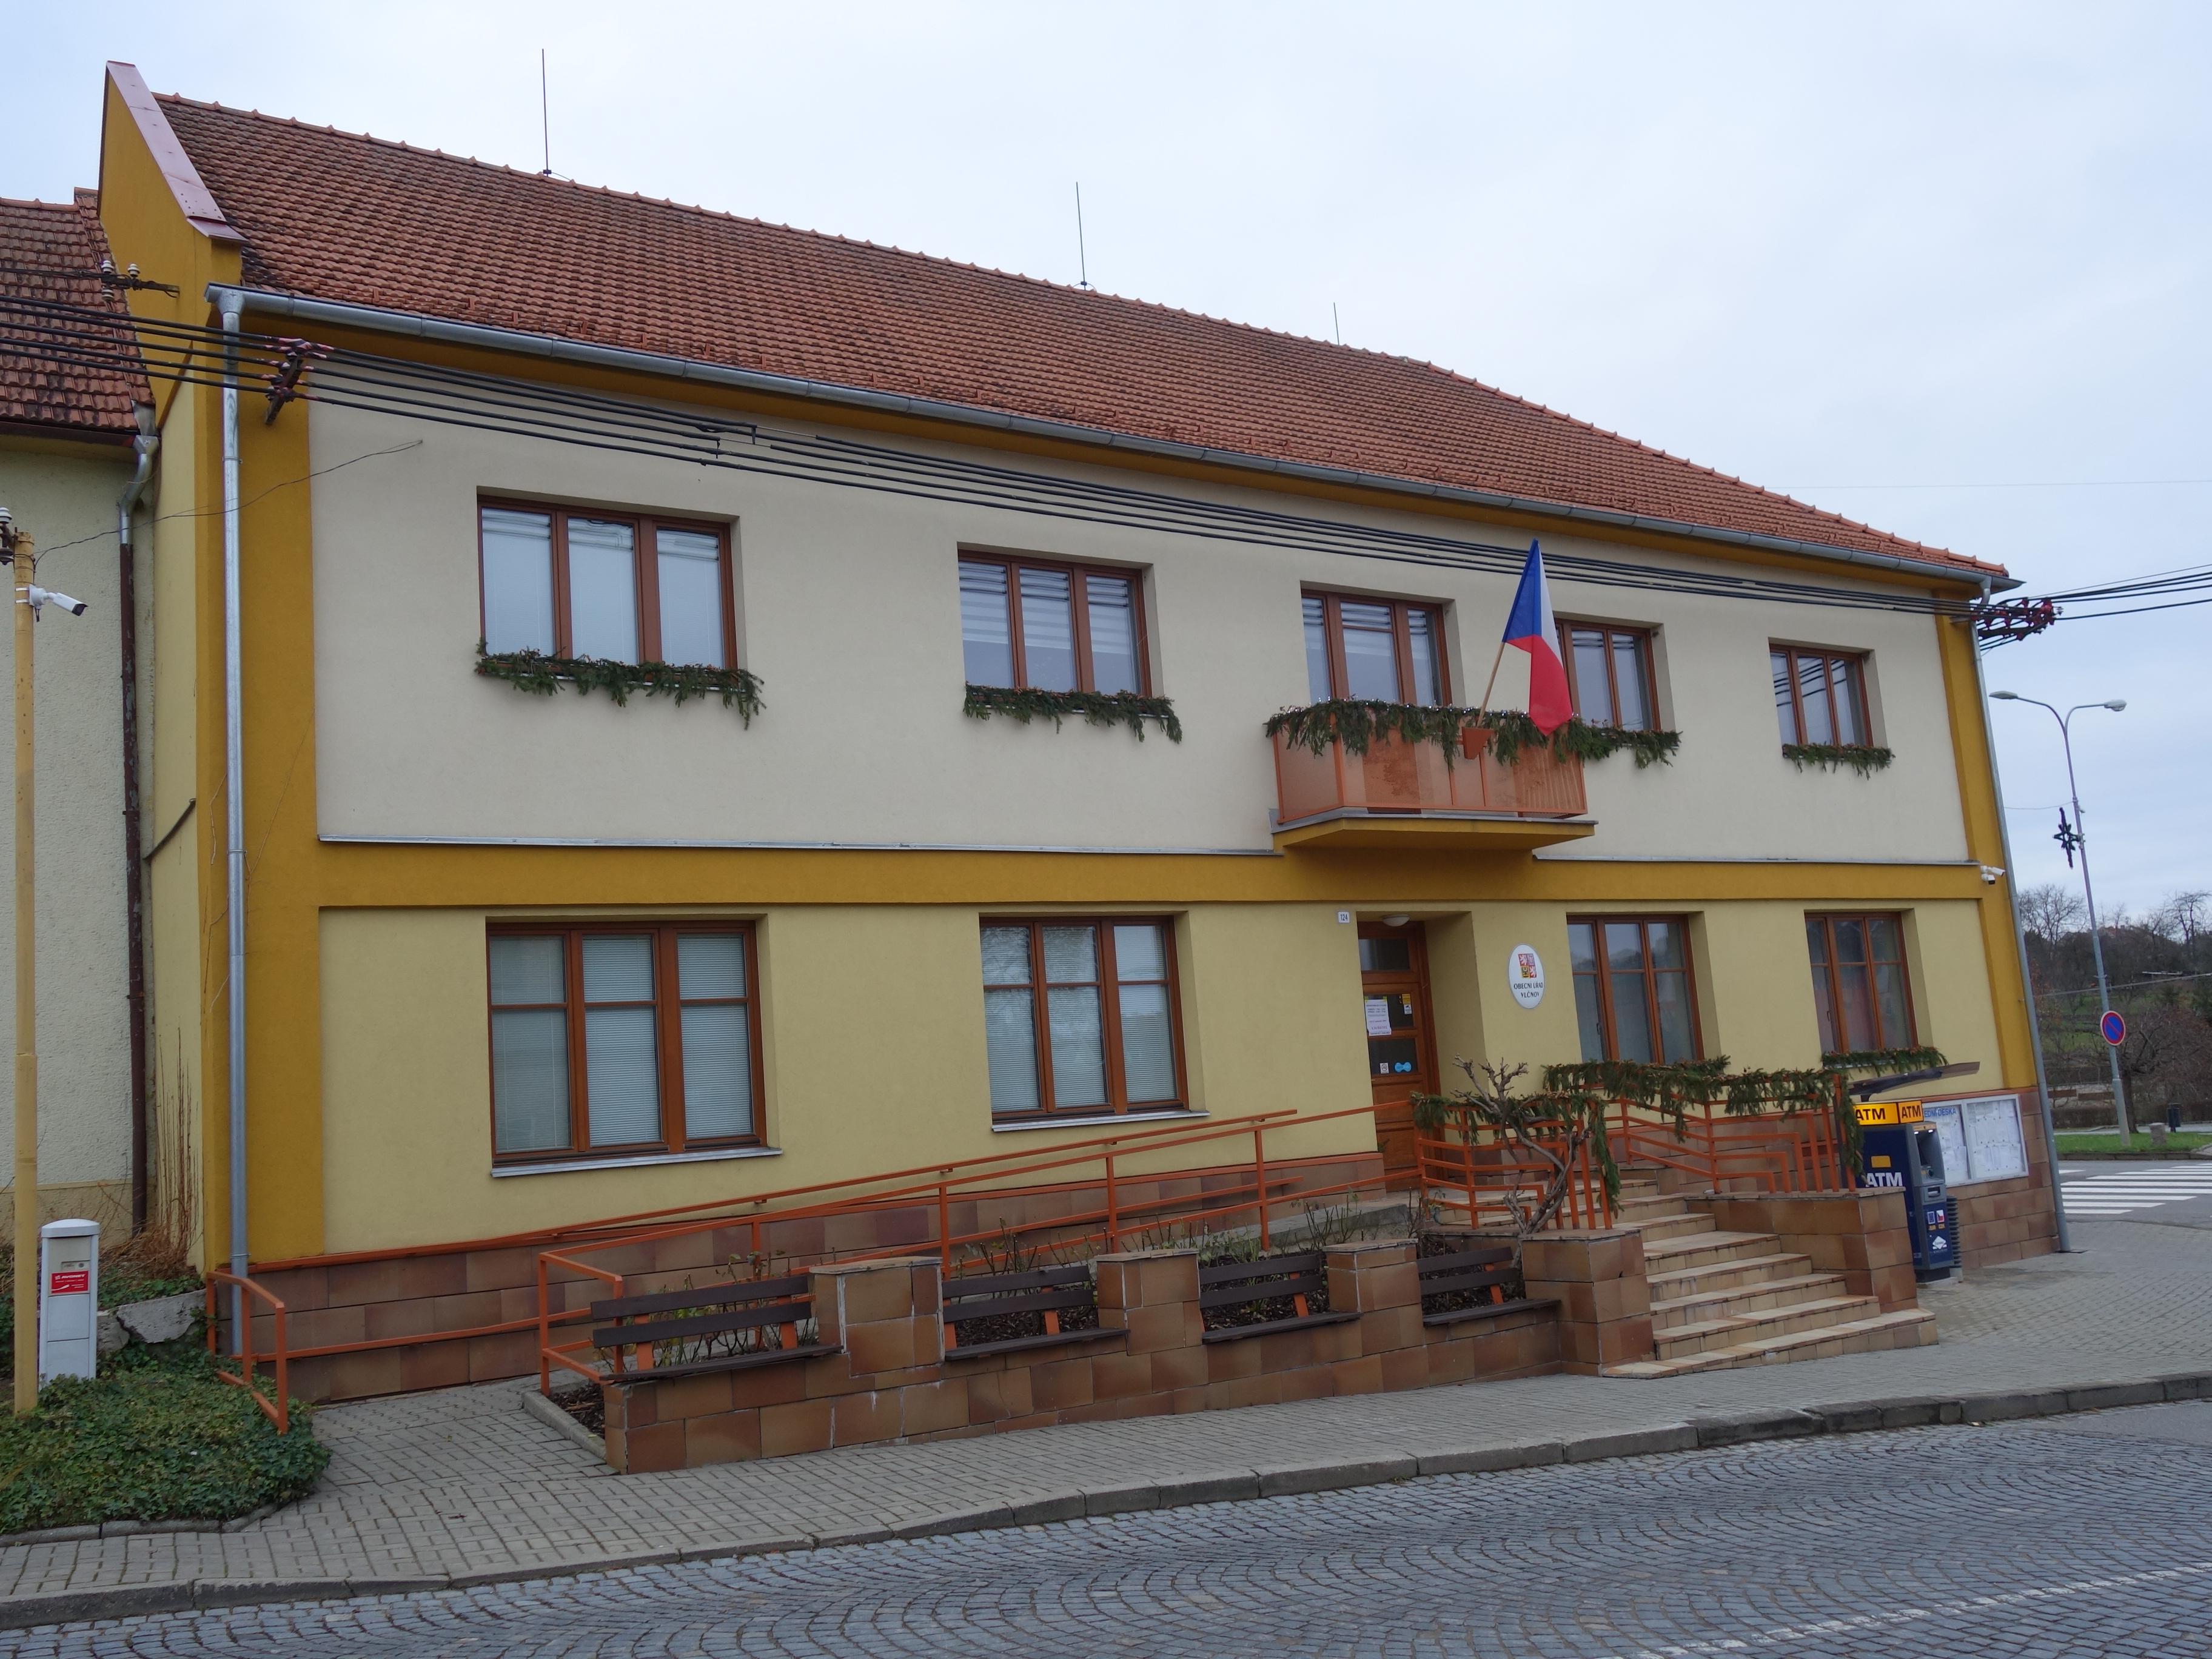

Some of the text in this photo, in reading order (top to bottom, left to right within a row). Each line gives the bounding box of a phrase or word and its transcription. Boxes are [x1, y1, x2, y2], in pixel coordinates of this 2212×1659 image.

[1855, 1105, 1922, 1121] ATM ATM
[1866, 1171, 1903, 1187] ATM
